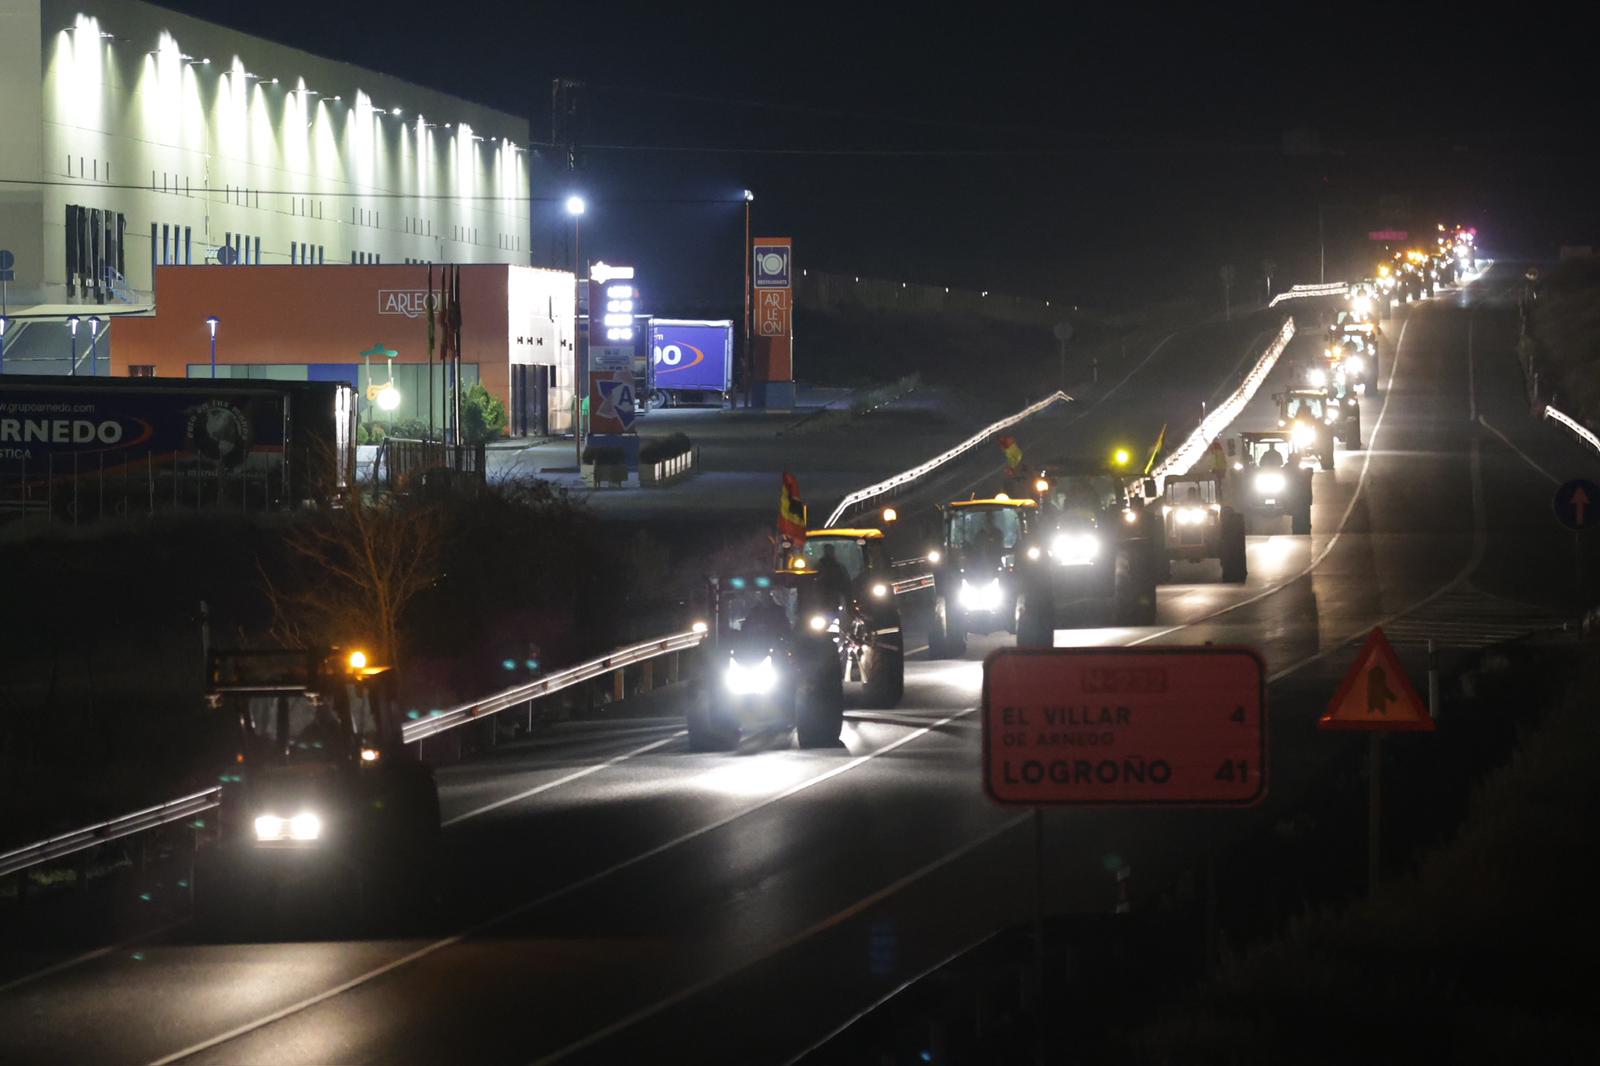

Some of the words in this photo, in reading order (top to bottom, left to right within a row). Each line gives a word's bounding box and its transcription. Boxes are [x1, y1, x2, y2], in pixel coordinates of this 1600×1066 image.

[765, 293, 787, 310] AR
[767, 309, 778, 320] LE
[763, 321, 782, 334] ON
[1002, 707, 1030, 725] EL
[1043, 707, 1132, 725] VILLAR
[1230, 706, 1246, 723] 4
[1002, 732, 1027, 747] DE
[1036, 732, 1115, 747] ARNEDO
[1003, 754, 1172, 785] LOGROÑO
[1214, 759, 1249, 785] 41
